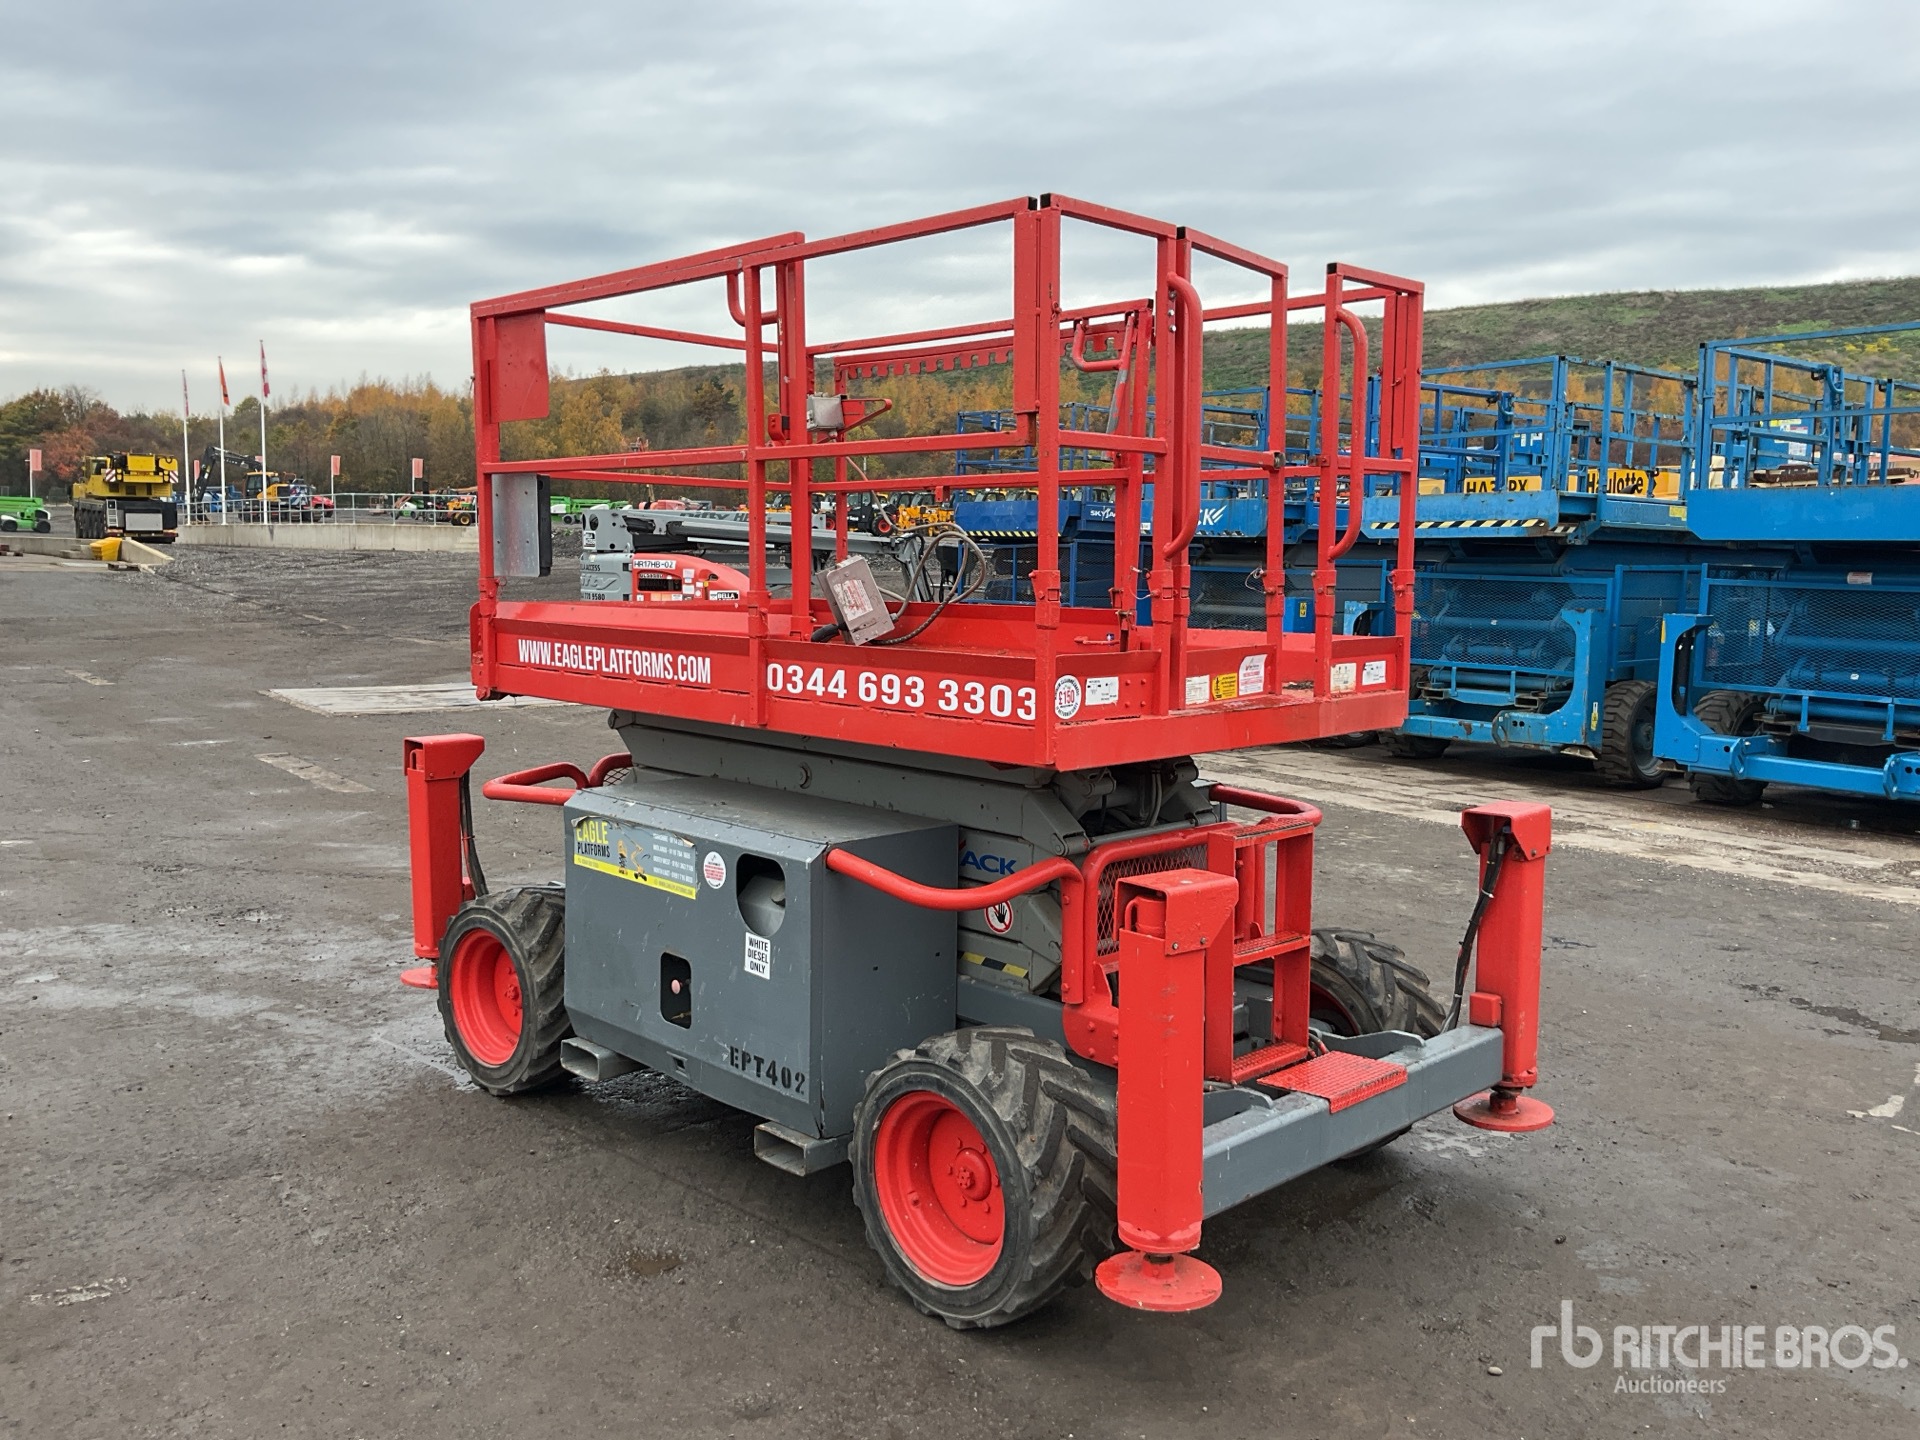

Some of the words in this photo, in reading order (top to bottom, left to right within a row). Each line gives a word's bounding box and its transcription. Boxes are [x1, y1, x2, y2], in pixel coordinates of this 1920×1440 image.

[1587, 472, 1643, 493] Hulotte
[518, 639, 711, 684] WWW.EAGLEPLATFORMS.COM
[767, 663, 847, 698] 0344
[858, 672, 925, 707] 693
[938, 679, 1036, 721] 3303
[576, 820, 608, 844] EAGLE
[577, 842, 610, 858] PLATFORMS
[960, 851, 1018, 875] ACK
[749, 937, 768, 952] WHITE
[747, 948, 768, 964] DIESEL
[750, 960, 766, 974] ONLY
[729, 1045, 806, 1095] EPT402
